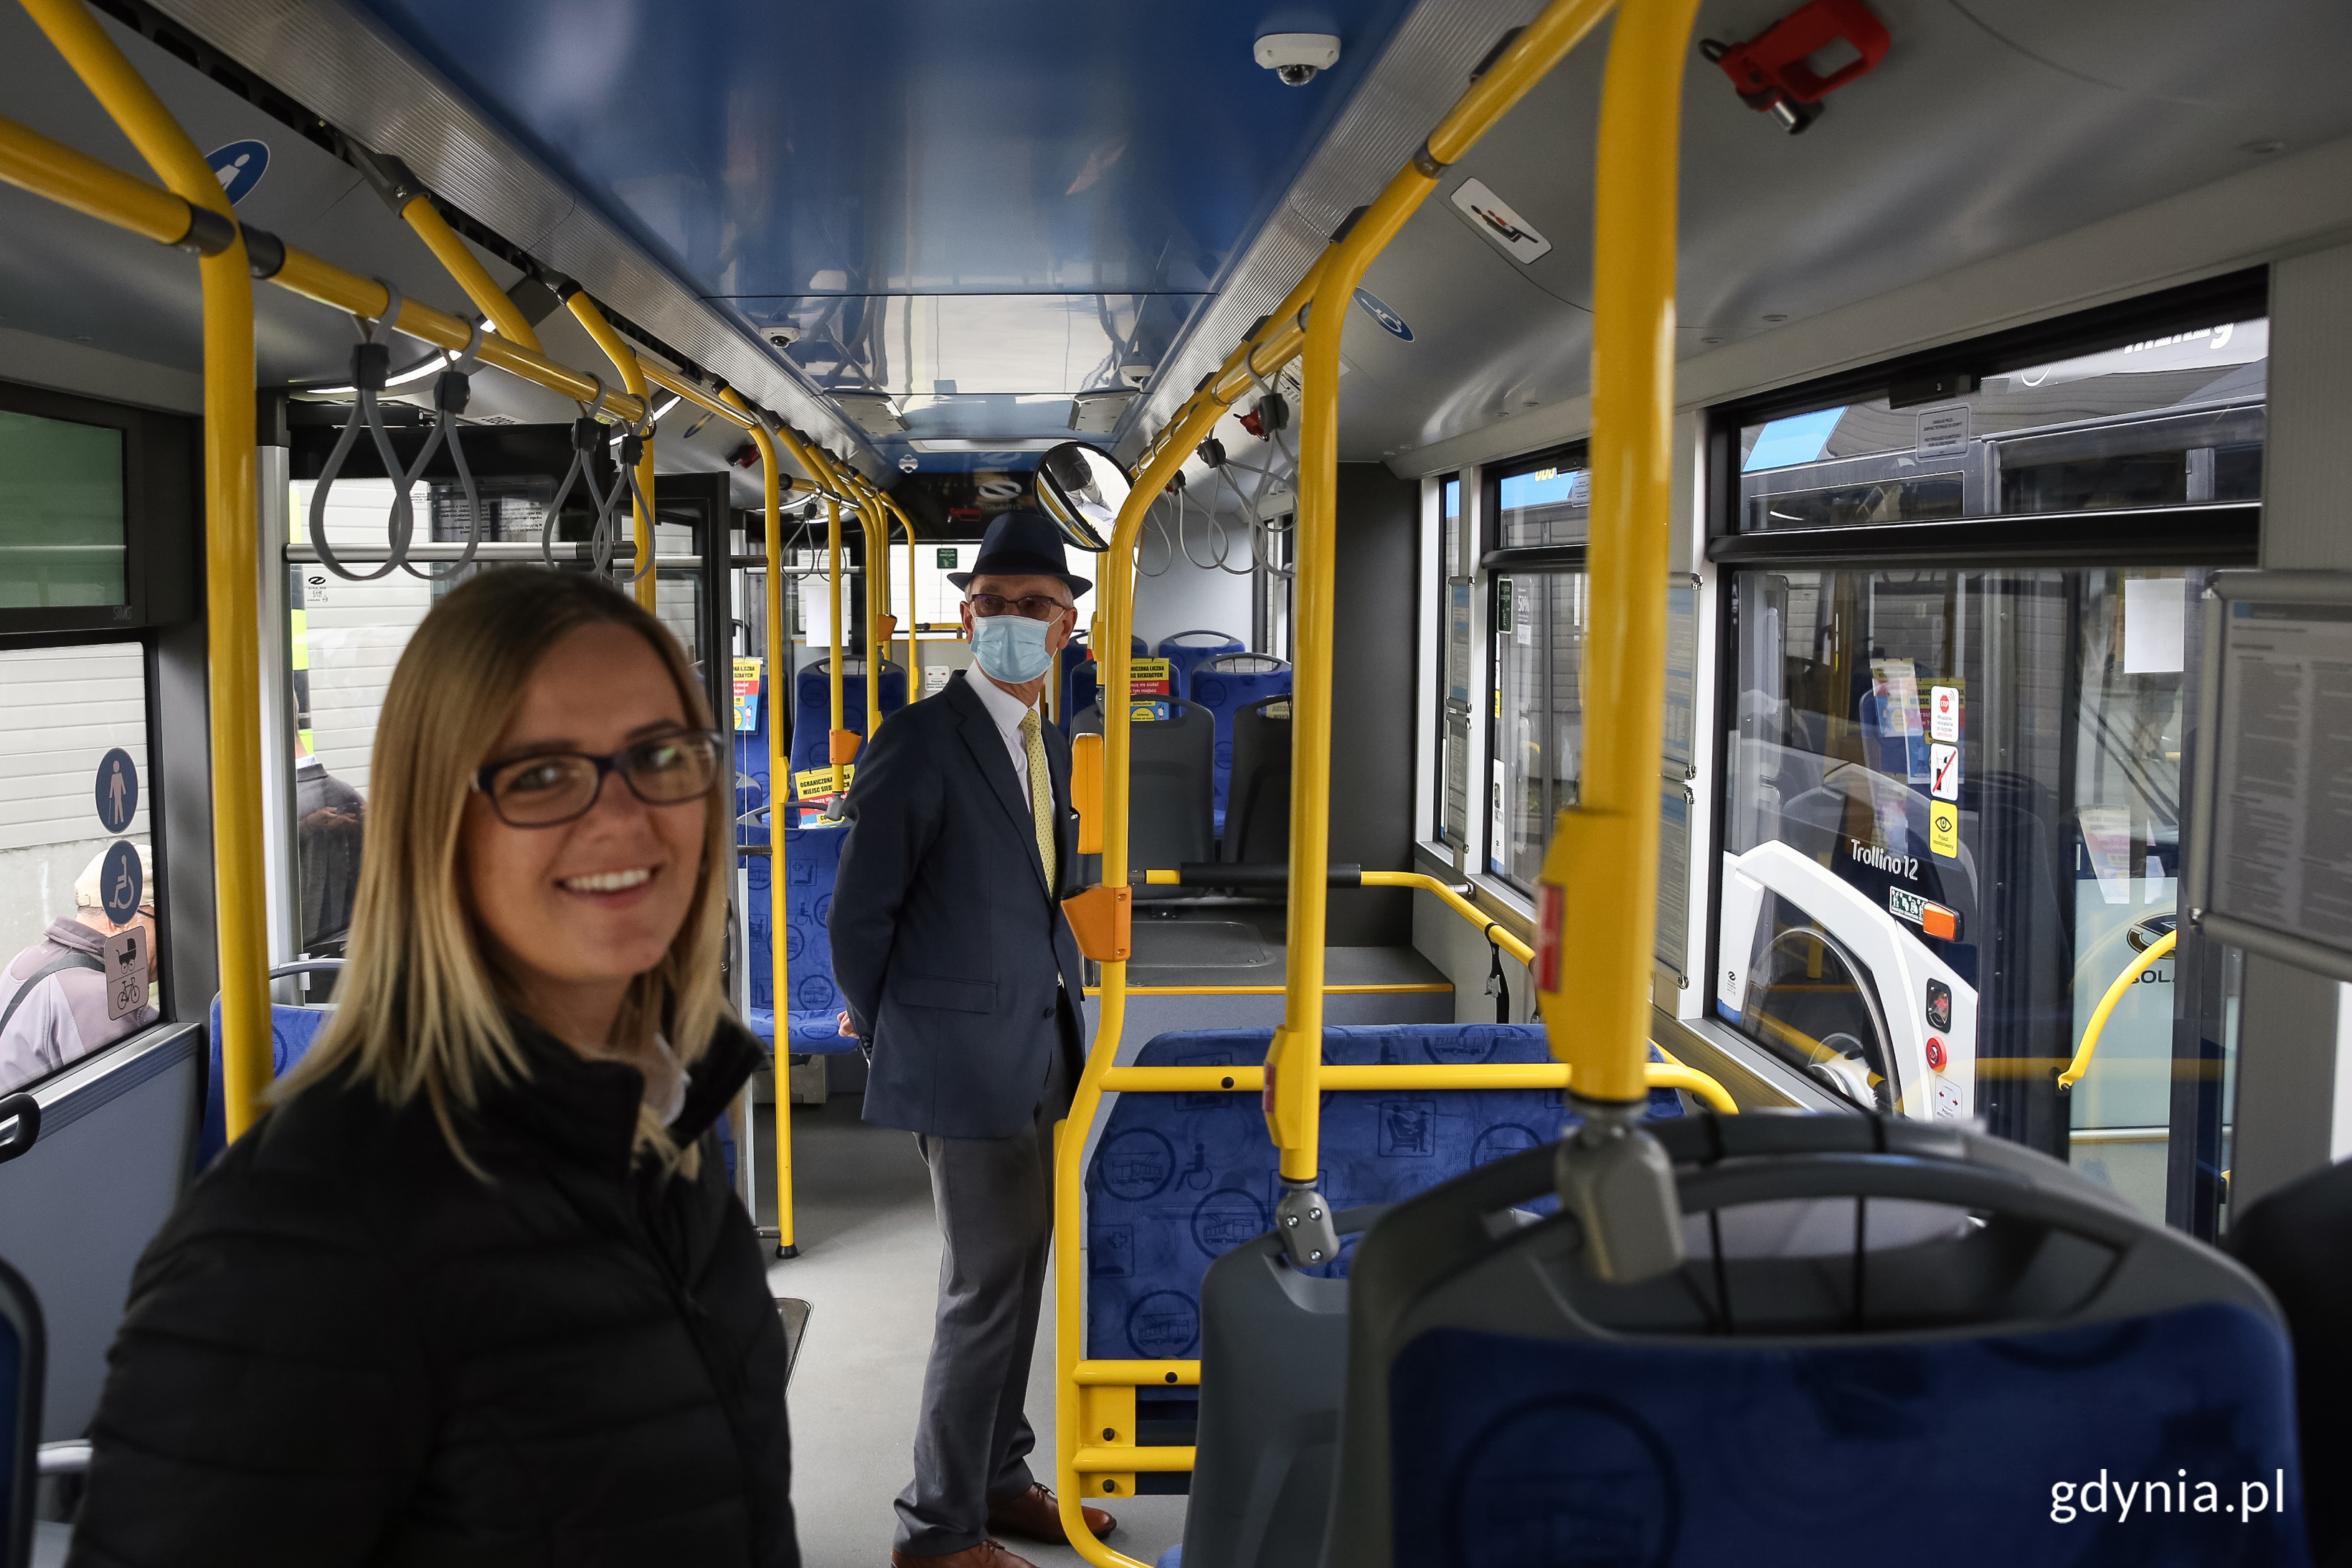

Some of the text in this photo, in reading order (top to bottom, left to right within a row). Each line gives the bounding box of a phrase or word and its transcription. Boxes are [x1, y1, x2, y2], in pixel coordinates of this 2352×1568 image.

[803, 787, 821, 795] MIEJSC
[1851, 839, 1918, 881] Trollino 12
